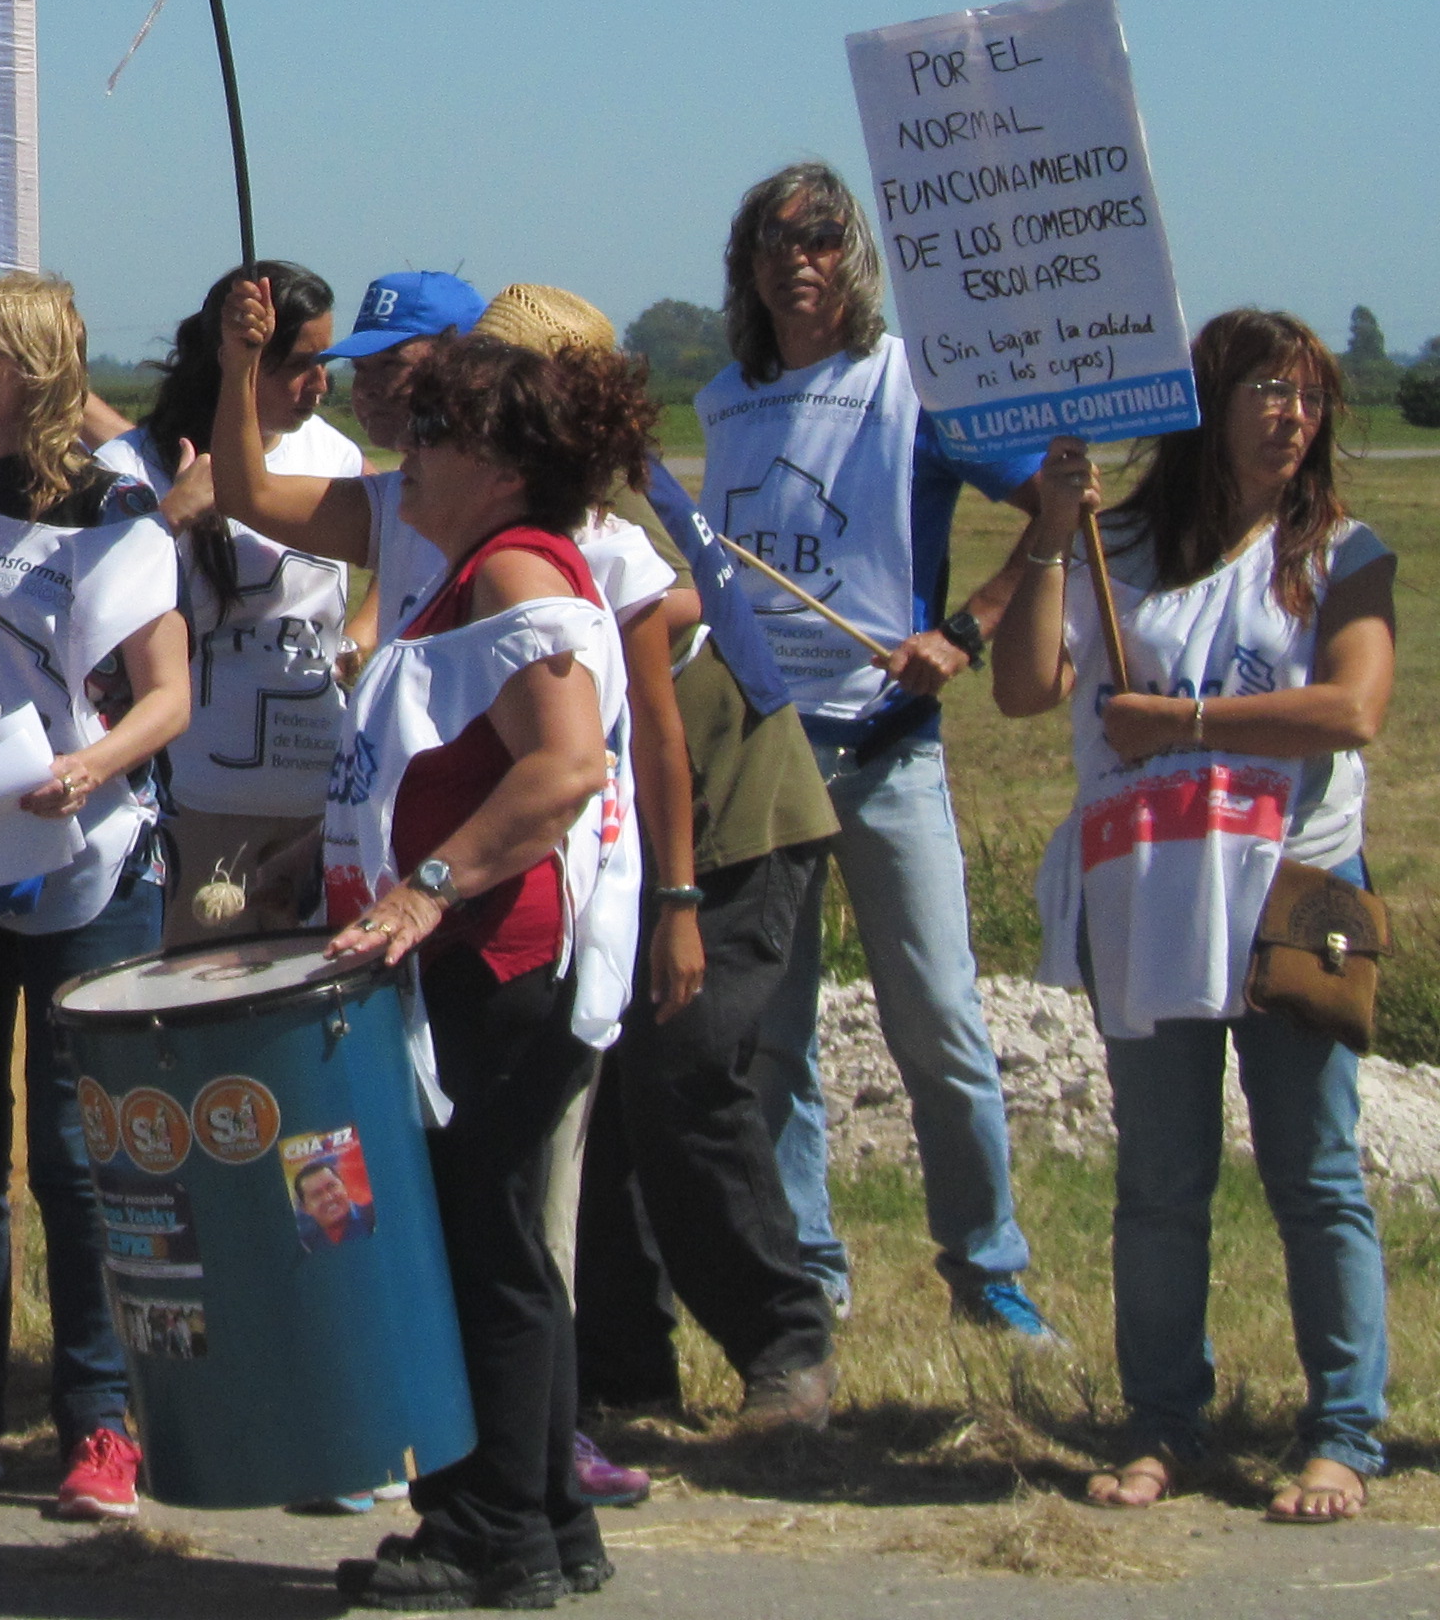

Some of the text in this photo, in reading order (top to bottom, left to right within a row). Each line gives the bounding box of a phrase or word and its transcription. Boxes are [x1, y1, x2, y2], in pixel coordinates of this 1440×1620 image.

[906, 36, 1043, 95] POR EL
[898, 106, 1044, 152] NORMAL
[880, 145, 1129, 222] FUNCIONAMIENTO
[893, 195, 1148, 272] DE LOS COMEDORES
[962, 254, 1102, 302] ESCOLARES
[989, 329, 1043, 358] bajar
[1056, 318, 1081, 342] la
[1088, 313, 1156, 340] calidad
[978, 373, 999, 389] ni
[1010, 361, 1037, 382] los
[758, 391, 877, 412] transformadora
[938, 417, 968, 442] LA
[972, 402, 1059, 441] LUCHA
[1060, 378, 1189, 424] CONTINÚA
